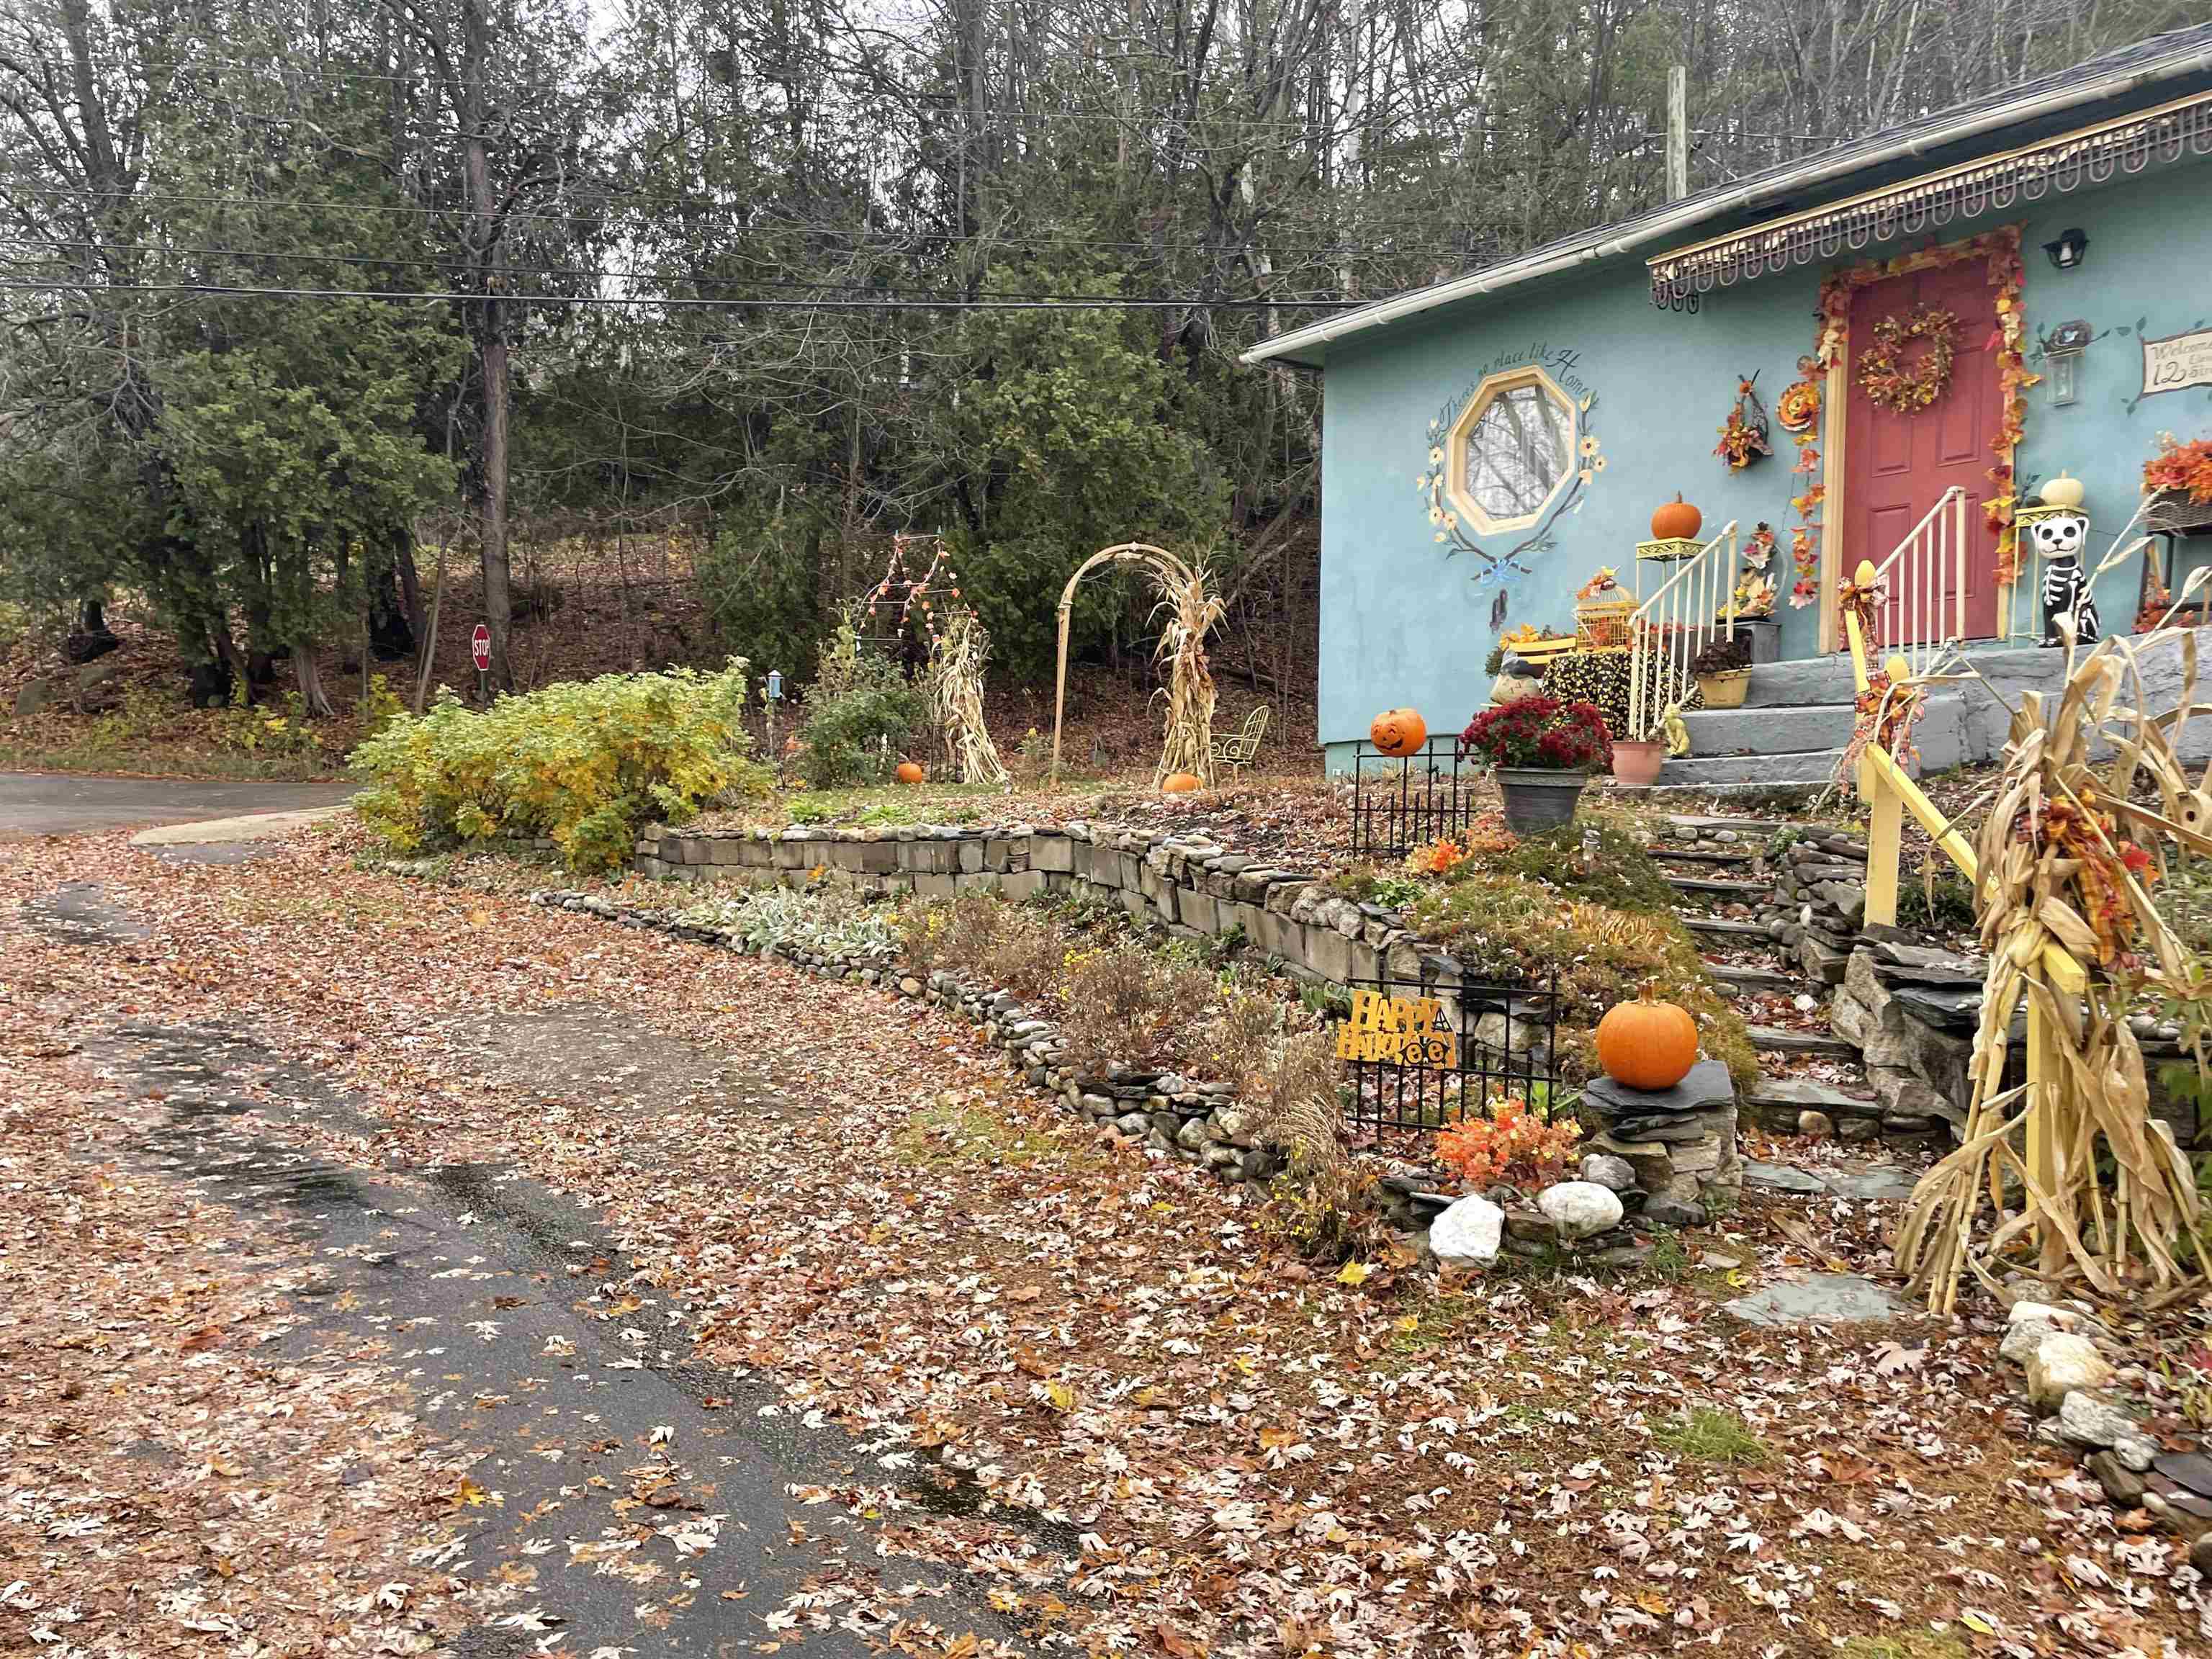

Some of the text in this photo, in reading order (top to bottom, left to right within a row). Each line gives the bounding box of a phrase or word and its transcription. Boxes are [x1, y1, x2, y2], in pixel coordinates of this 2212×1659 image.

[1478, 362, 1488, 378] no
[1494, 348, 1524, 368] place
[1529, 341, 1555, 361] like
[1545, 349, 1590, 396] Home
[2154, 361, 2188, 385] 12
[475, 639, 490, 656] STOP
[1351, 989, 1441, 1033] HAPPY
